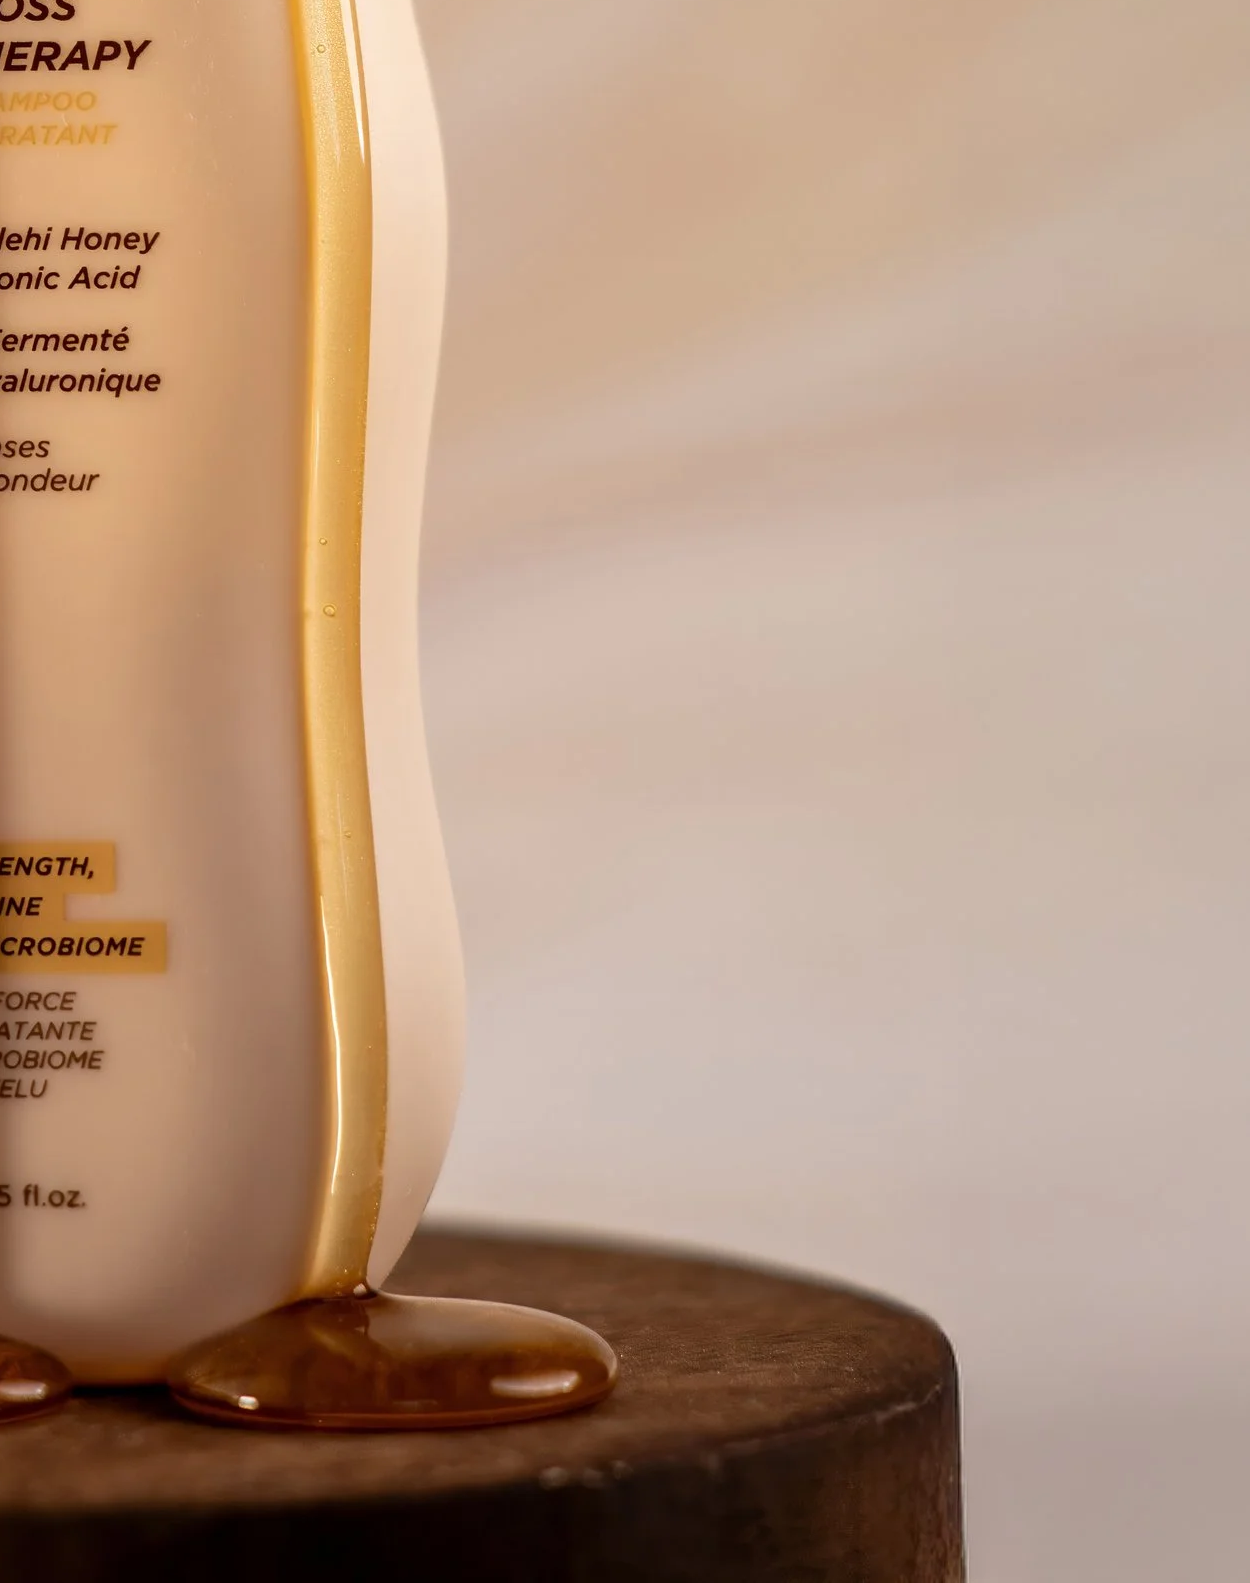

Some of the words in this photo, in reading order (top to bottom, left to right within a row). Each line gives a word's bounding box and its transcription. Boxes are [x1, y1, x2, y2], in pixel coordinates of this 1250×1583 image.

[61, 227, 160, 255] Honey
[68, 265, 141, 290] Acid
[22, 1184, 86, 1208] fl.oz.
